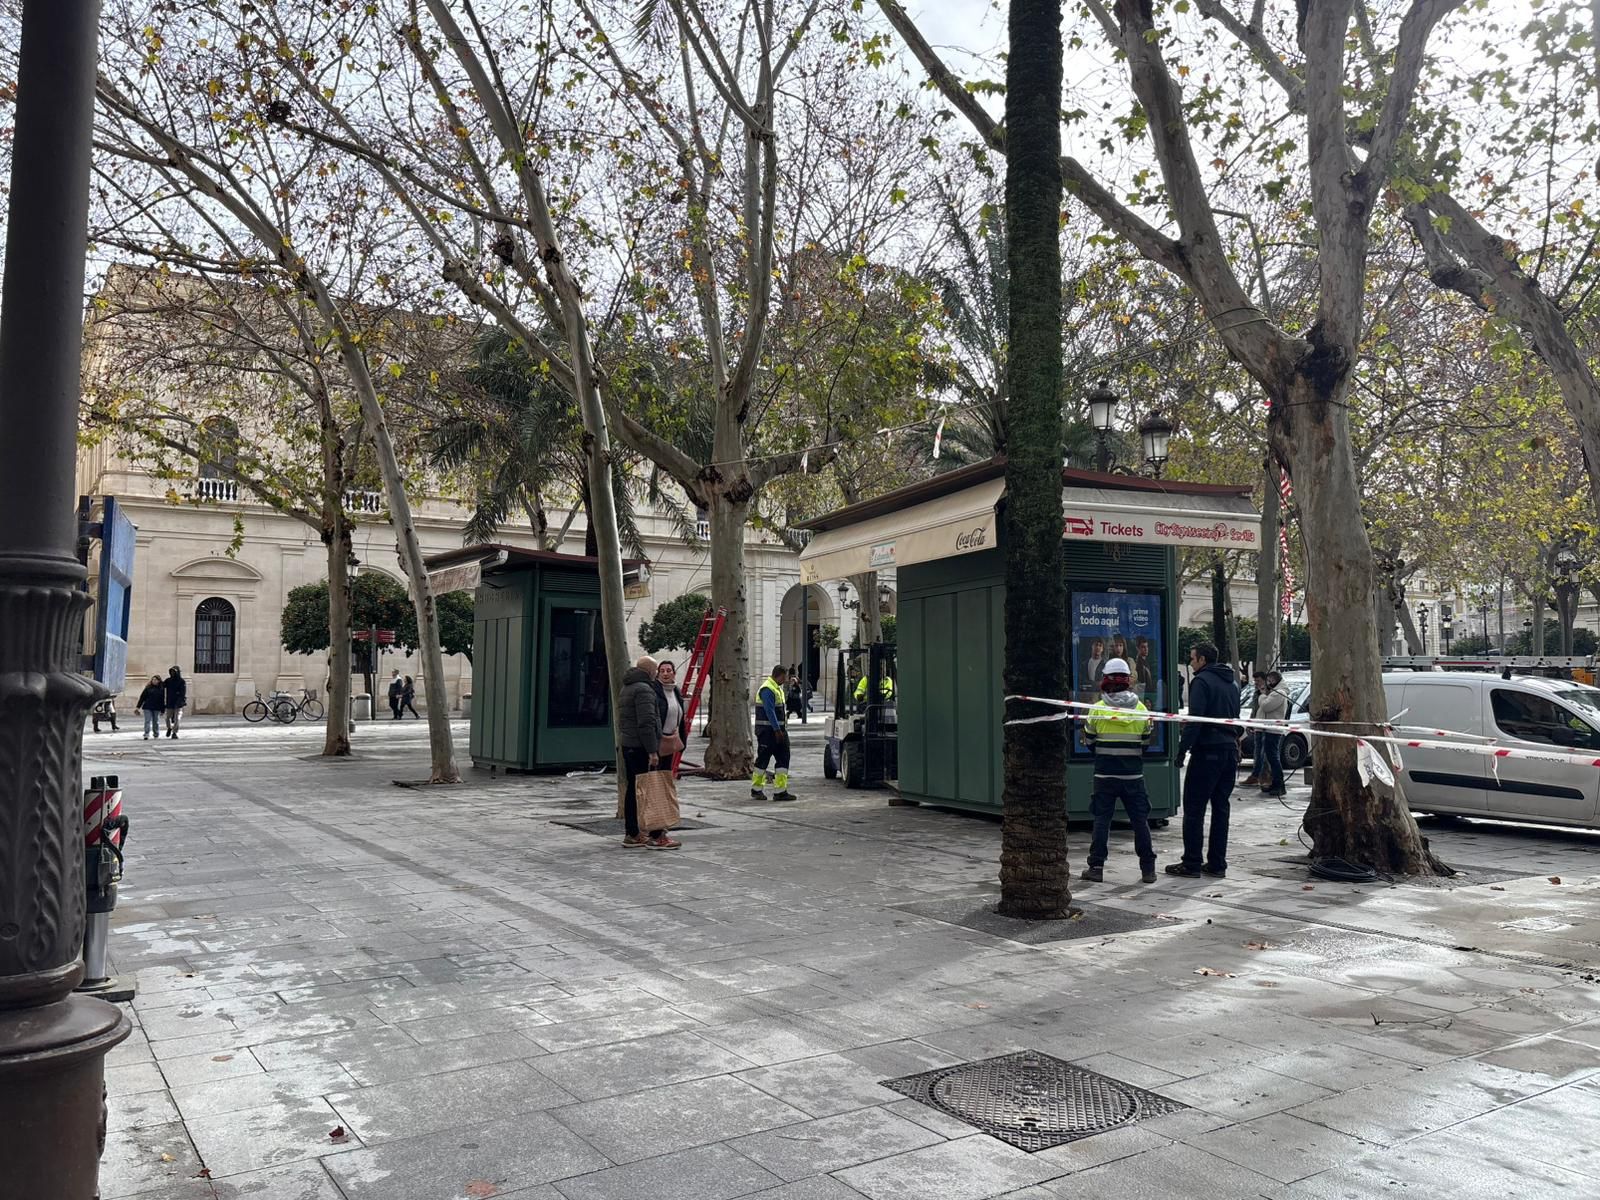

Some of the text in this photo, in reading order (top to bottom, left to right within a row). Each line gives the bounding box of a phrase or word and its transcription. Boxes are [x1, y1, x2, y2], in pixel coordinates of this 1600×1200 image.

[1100, 521, 1143, 537] Tickets
[1230, 528, 1255, 542] Sevilla
[1080, 603, 1118, 615] Lo tienes
[1080, 615, 1120, 627] todo aquí
